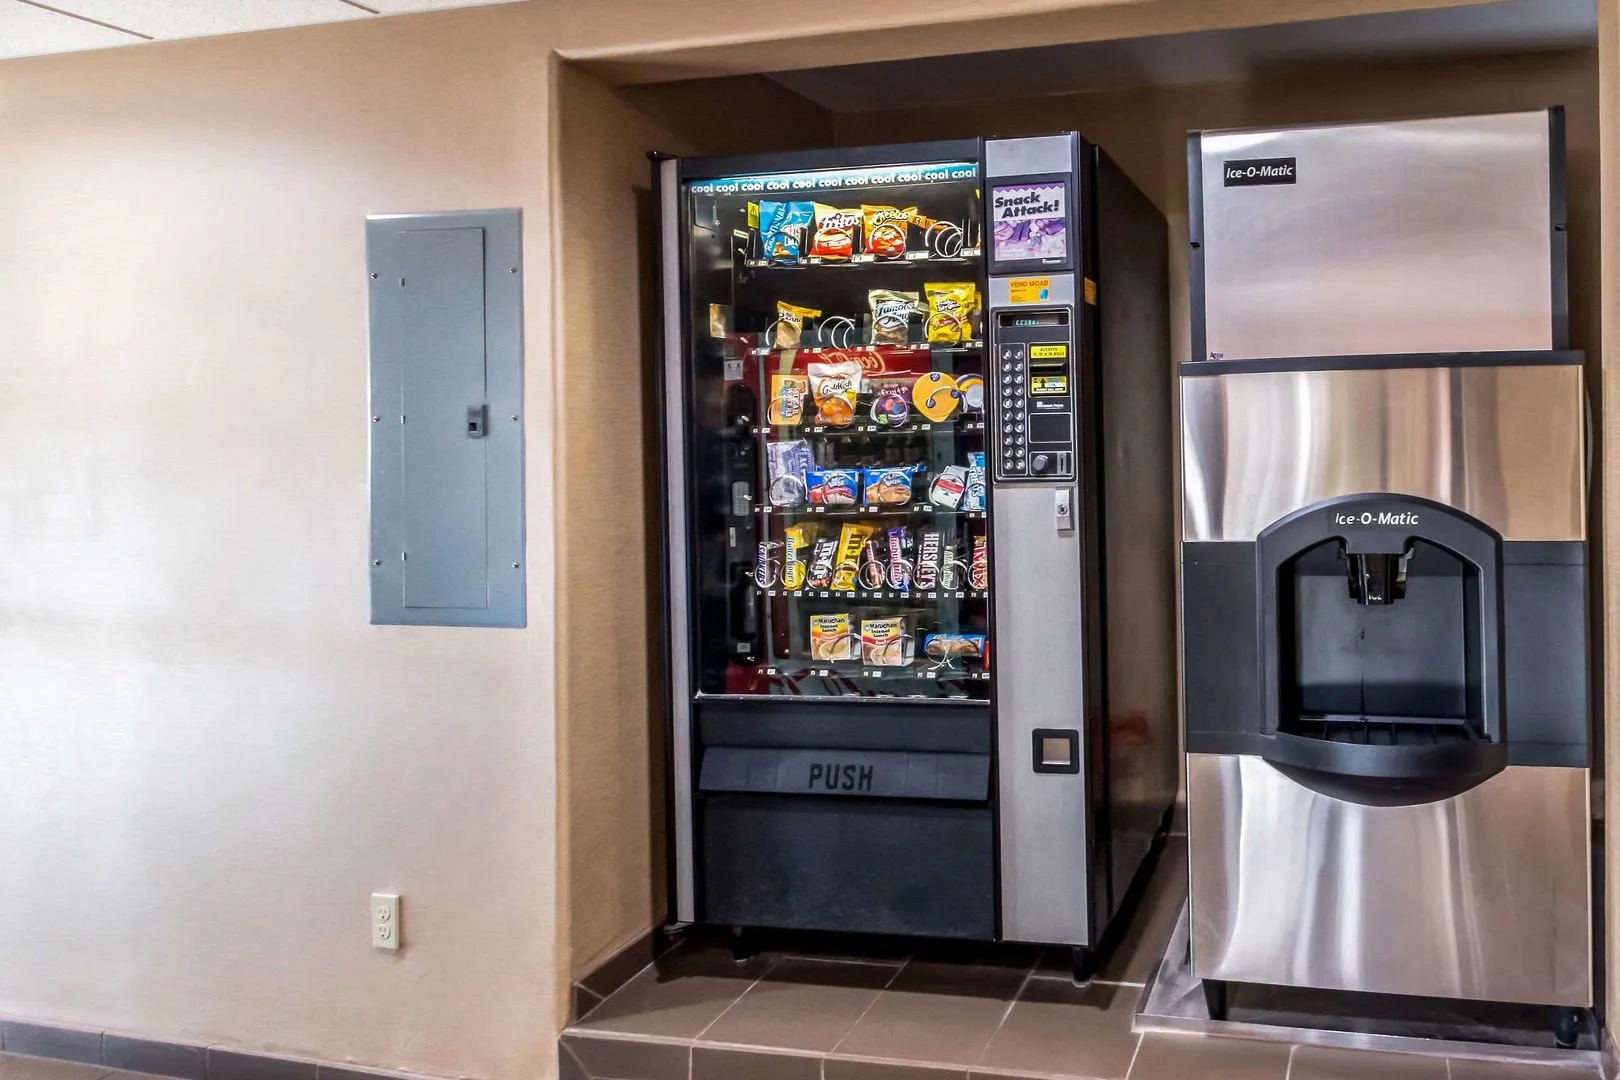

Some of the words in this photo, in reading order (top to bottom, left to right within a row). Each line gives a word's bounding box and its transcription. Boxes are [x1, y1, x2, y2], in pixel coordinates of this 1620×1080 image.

[691, 183, 713, 193] cool
[716, 182, 739, 192] cool
[741, 181, 764, 191] cool
[767, 180, 790, 190] cool
[793, 179, 815, 189] cool
[819, 178, 842, 188] cool
[845, 175, 868, 185] cool
[871, 174, 894, 184] cool
[898, 171, 921, 182] cool
[925, 169, 948, 180] cool
[952, 167, 976, 178] cool
[1226, 165, 1293, 179] Ice-O-Matic
[994, 191, 1041, 208] Snack
[1001, 199, 1060, 218] Attack!
[1335, 511, 1419, 525] Ice-O-Matic
[919, 533, 940, 590] HERSHEY'S
[818, 617, 845, 625] Maruchan
[869, 622, 897, 630] Maruchan
[808, 763, 874, 791] PUSH
